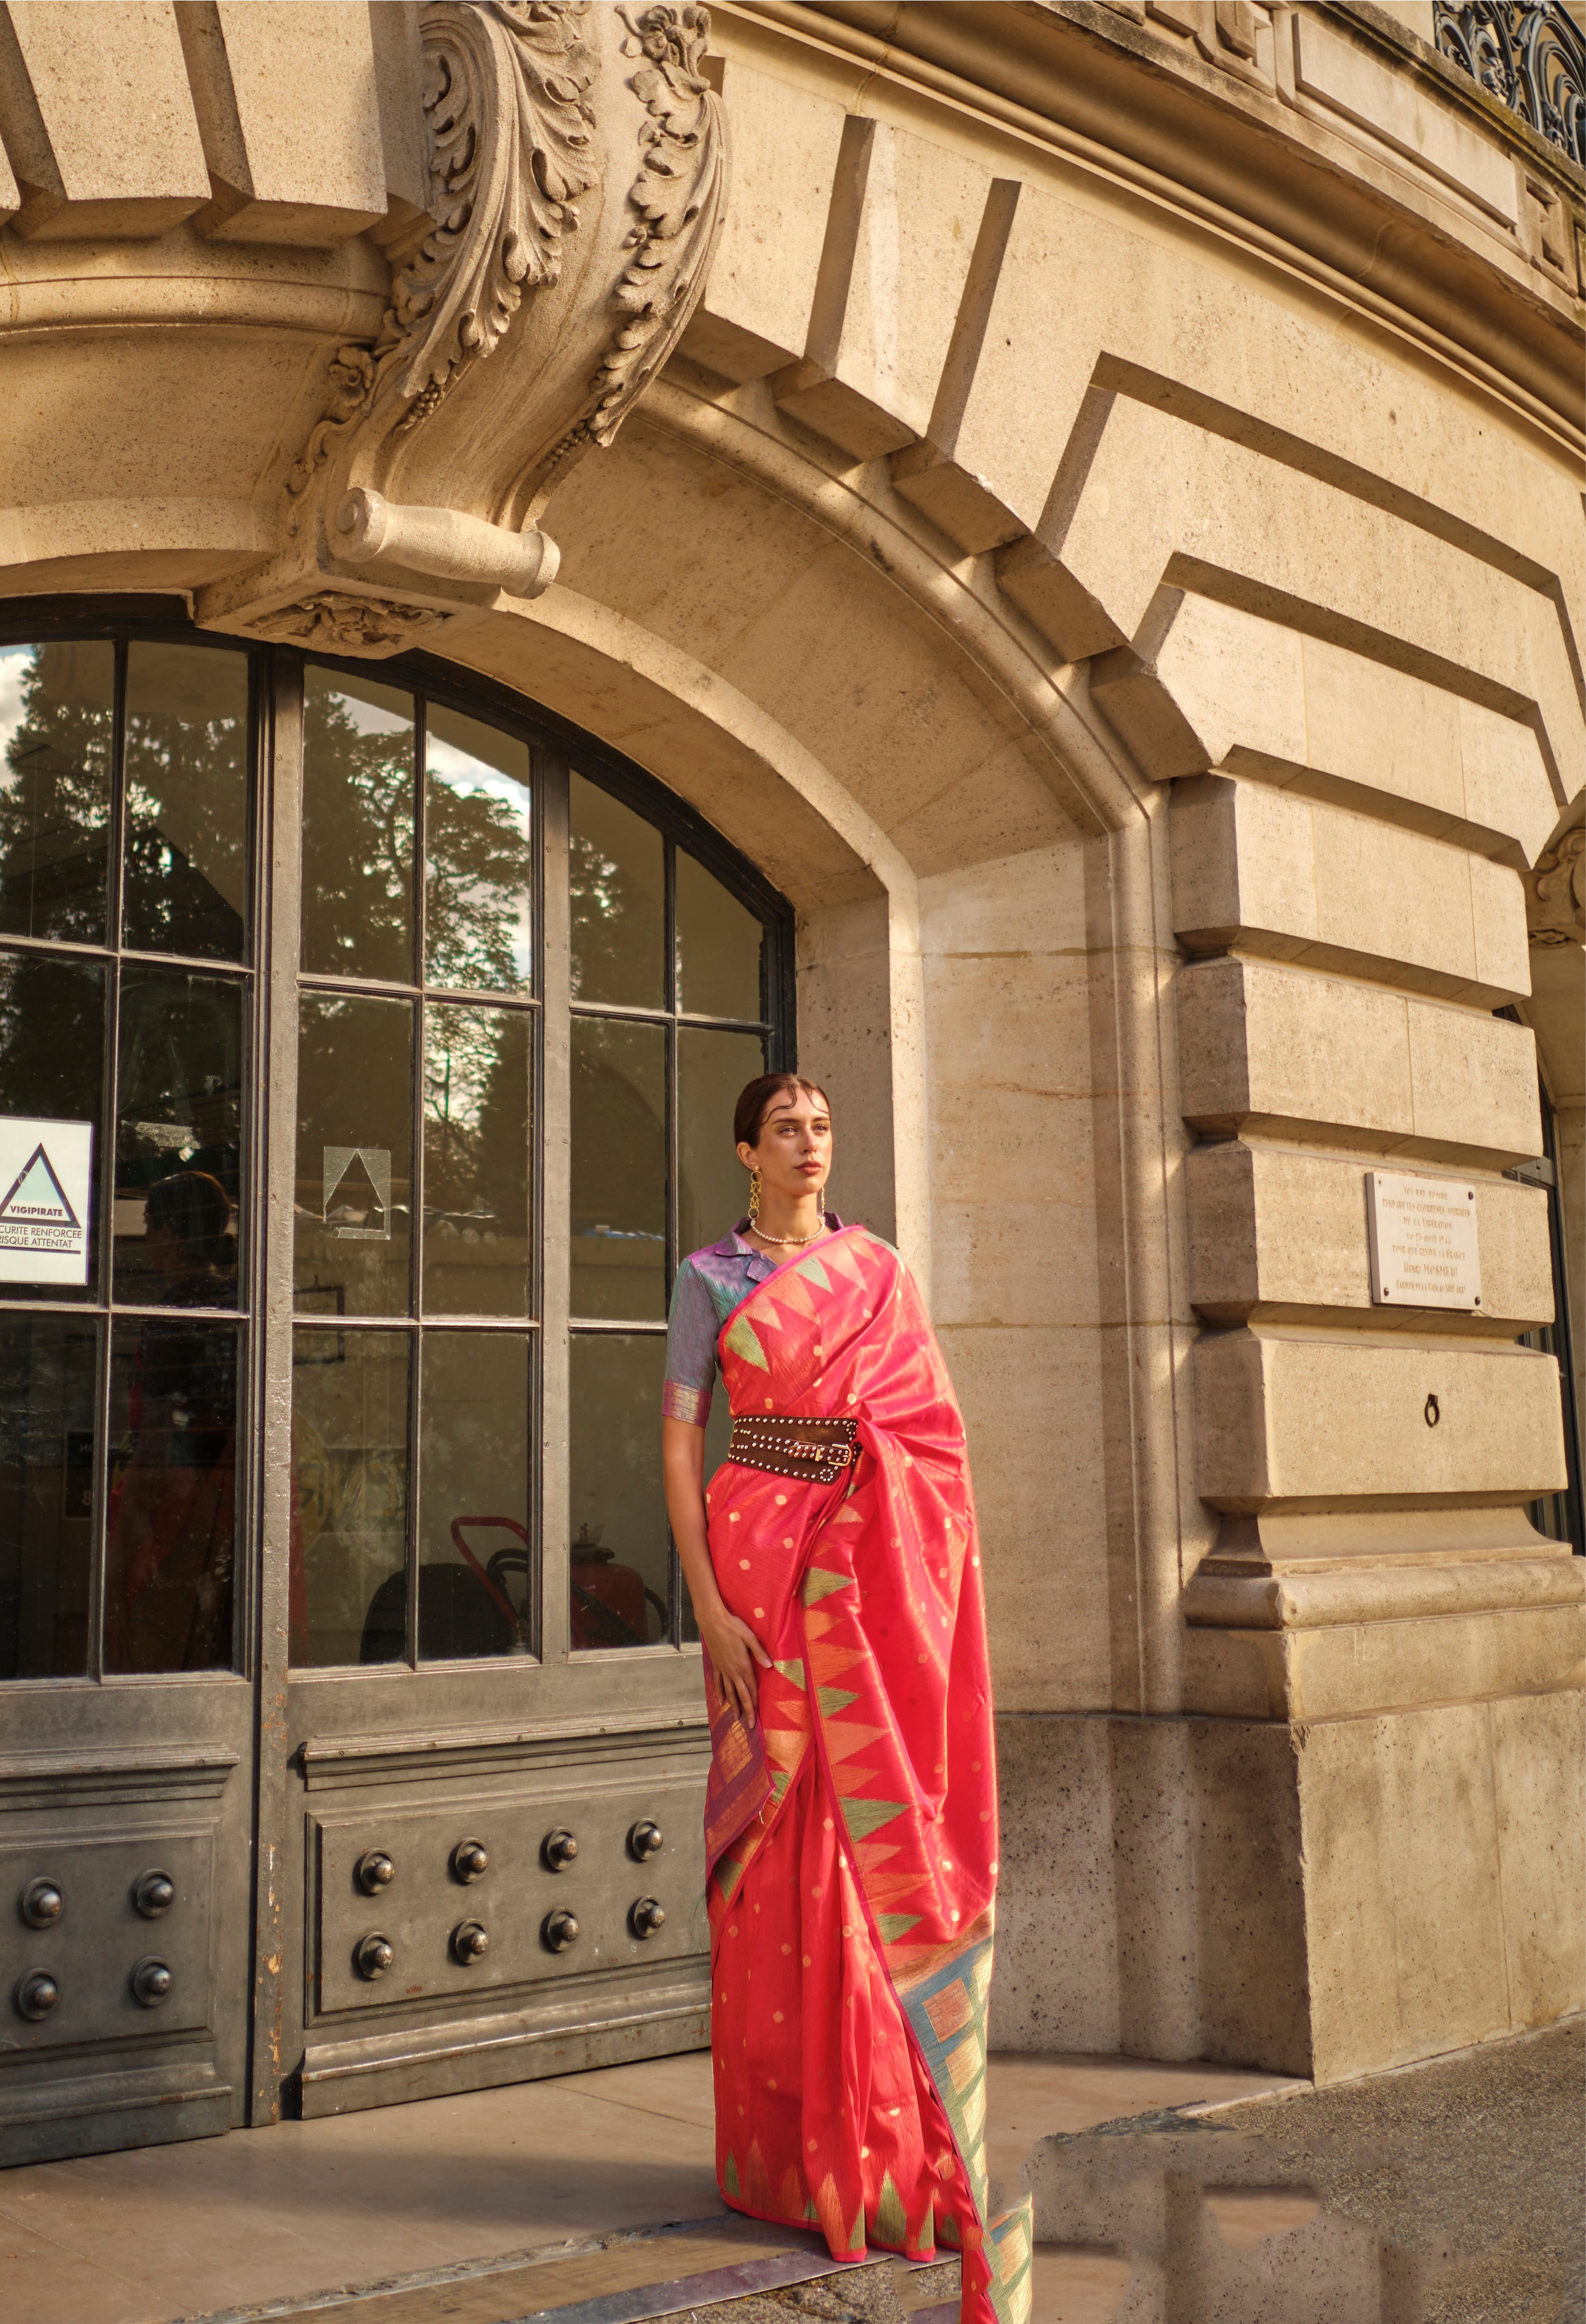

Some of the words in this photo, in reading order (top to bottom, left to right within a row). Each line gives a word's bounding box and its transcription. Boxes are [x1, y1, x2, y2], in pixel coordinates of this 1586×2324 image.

[1404, 1187, 1413, 1196] ICI
[1416, 1189, 1425, 1197] EST
[10, 1205, 63, 1216] VIGIPIRATE
[1382, 1198, 1405, 1209] PENDANT
[1406, 1202, 1415, 1210] LES
[1416, 1204, 1445, 1214] GLORIEUSES
[1404, 1217, 1410, 1226] DE
[1414, 1217, 1421, 1227] LA
[31, 1227, 82, 1239] RENFORCEE
[31, 1238, 73, 1248] ATTENTAT
[1393, 1244, 1406, 1254] POUR
[1407, 1247, 1417, 1256] QUE
[1420, 1248, 1436, 1258] REVIVE
[1439, 1249, 1445, 1258] LA
[1446, 1249, 1466, 1260] FRANCE
